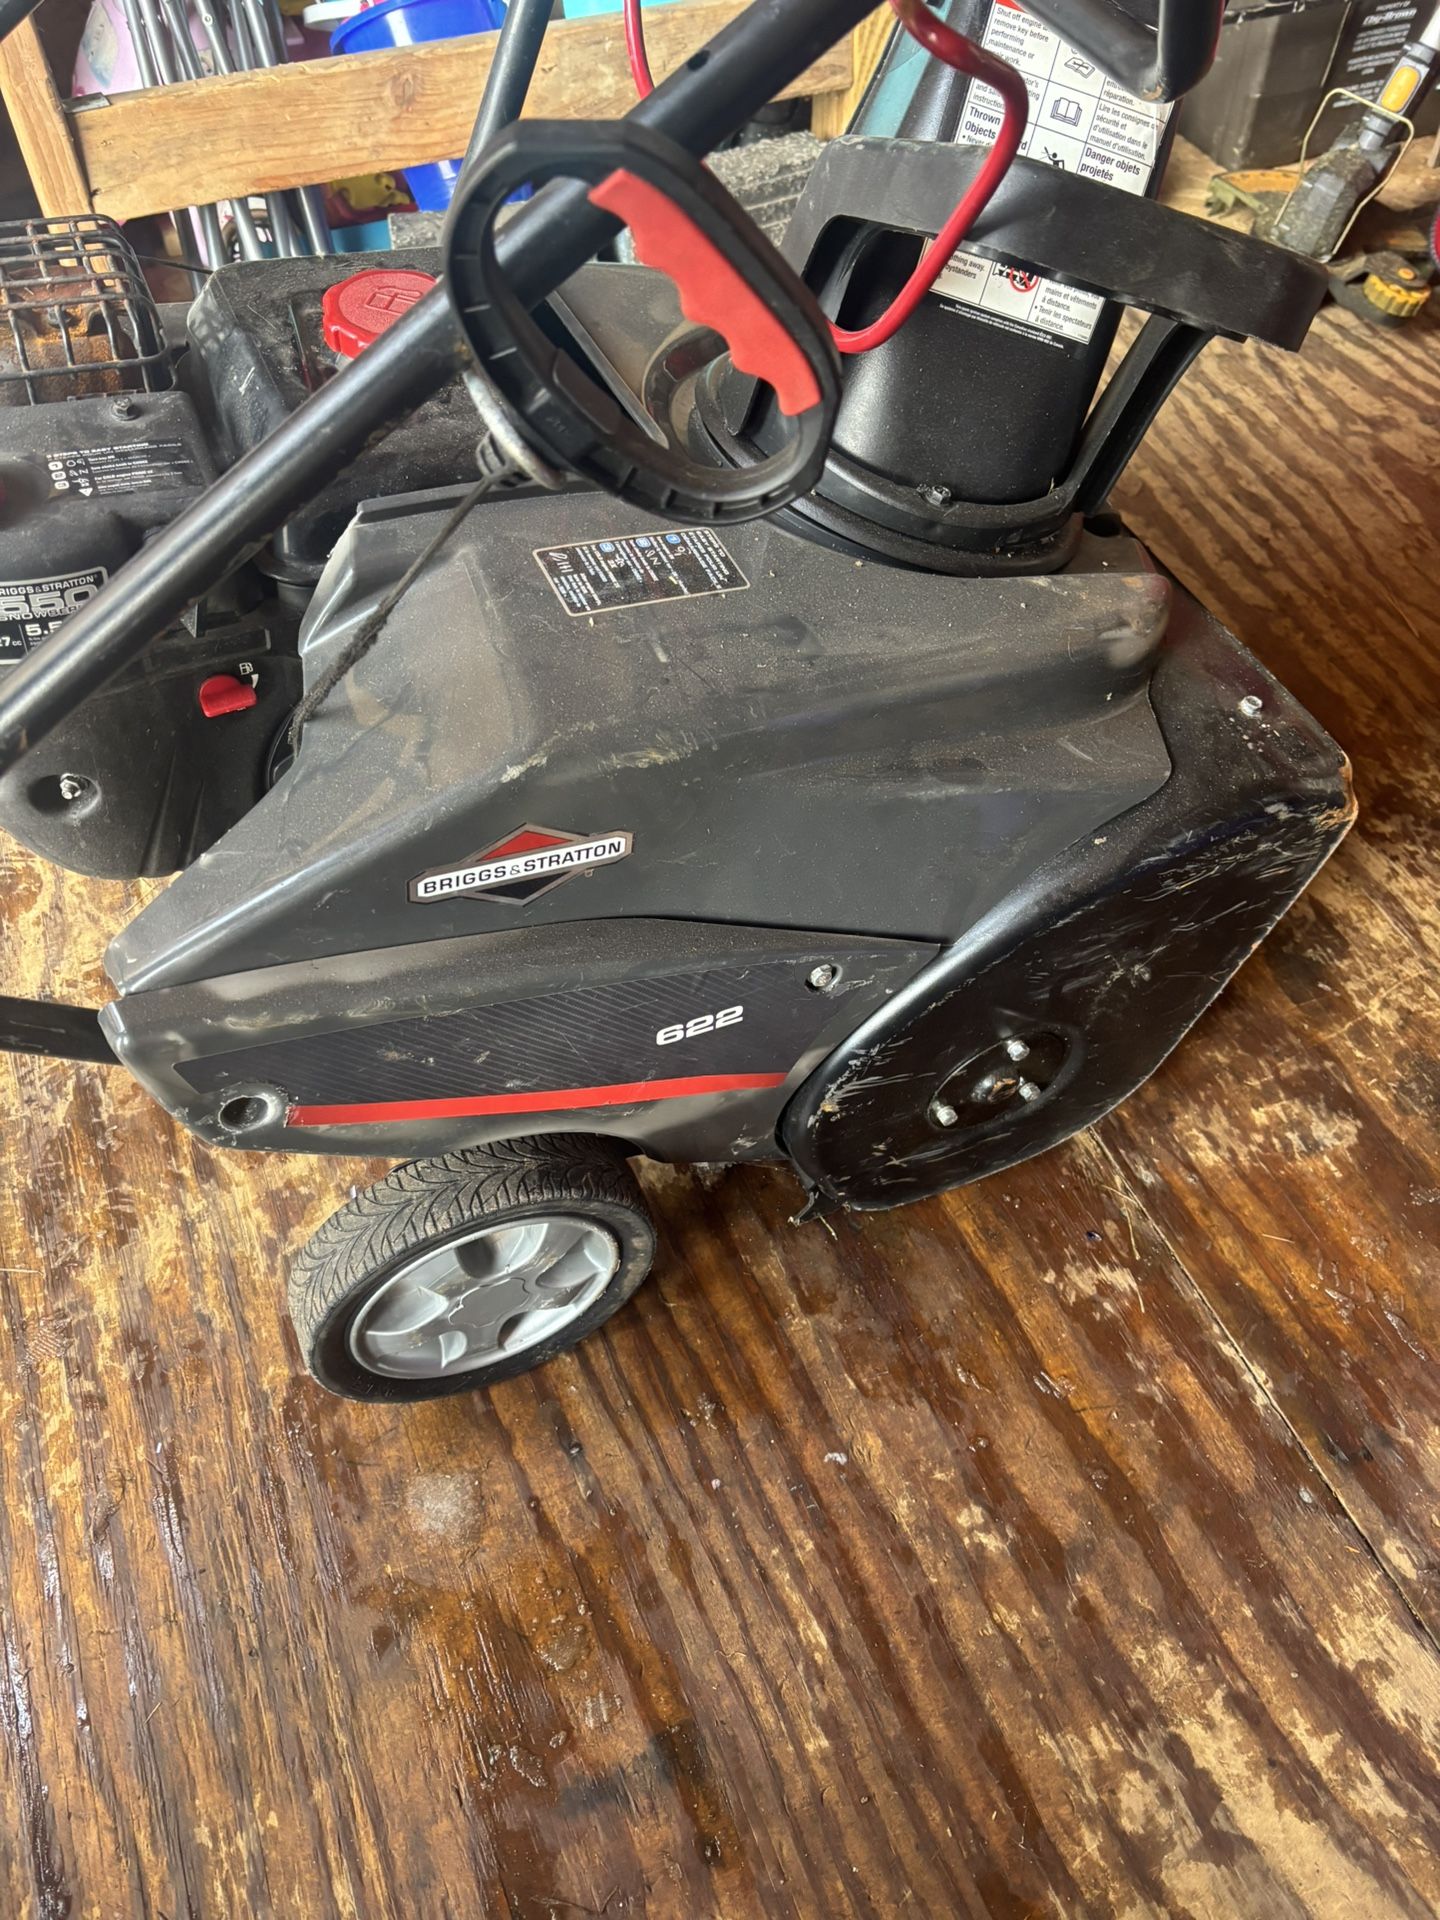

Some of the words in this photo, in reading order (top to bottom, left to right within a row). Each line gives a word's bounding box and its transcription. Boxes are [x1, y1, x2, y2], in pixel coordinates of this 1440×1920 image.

[997, 7, 1011, 18] Shut
[1012, 13, 1021, 21] off
[1021, 16, 1042, 29] engine
[991, 28, 1024, 46] performing
[993, 18, 1017, 31] remove
[1018, 26, 1028, 36] key
[1029, 29, 1049, 42] before
[988, 38, 1027, 57] maintenance
[976, 83, 987, 93] and
[1025, 78, 1039, 88] tor's
[973, 93, 1005, 110] instruction
[1103, 89, 1135, 106] réparation.
[970, 106, 1001, 125] Thrown
[1096, 114, 1120, 128] sécurité
[1099, 103, 1110, 113] Lire
[1111, 107, 1120, 117] les
[1121, 112, 1150, 127] consignes
[965, 121, 996, 139] Objects
[1093, 123, 1126, 142] d'utilisation
[1127, 136, 1141, 148] dans
[1142, 141, 1148, 149] le
[1089, 134, 1112, 149] manuel
[1085, 147, 1115, 165] Danger
[1115, 159, 1140, 176] objets
[1080, 163, 1114, 181] projetés
[951, 255, 968, 266] thing
[1045, 287, 1063, 297] mains
[1070, 295, 1097, 310] vêtements
[1039, 305, 1052, 315] Tenir
[1053, 310, 1061, 319] les
[1062, 315, 1092, 330] spectateurs
[706, 546, 730, 575] STARTING
[0, 585, 34, 596] RIGGS
[42, 575, 94, 591] STRATTON
[0, 604, 82, 621] SNOWSER
[424, 865, 507, 894] BRIGGS
[523, 841, 621, 872] STRATTON
[655, 1005, 744, 1046] 622
